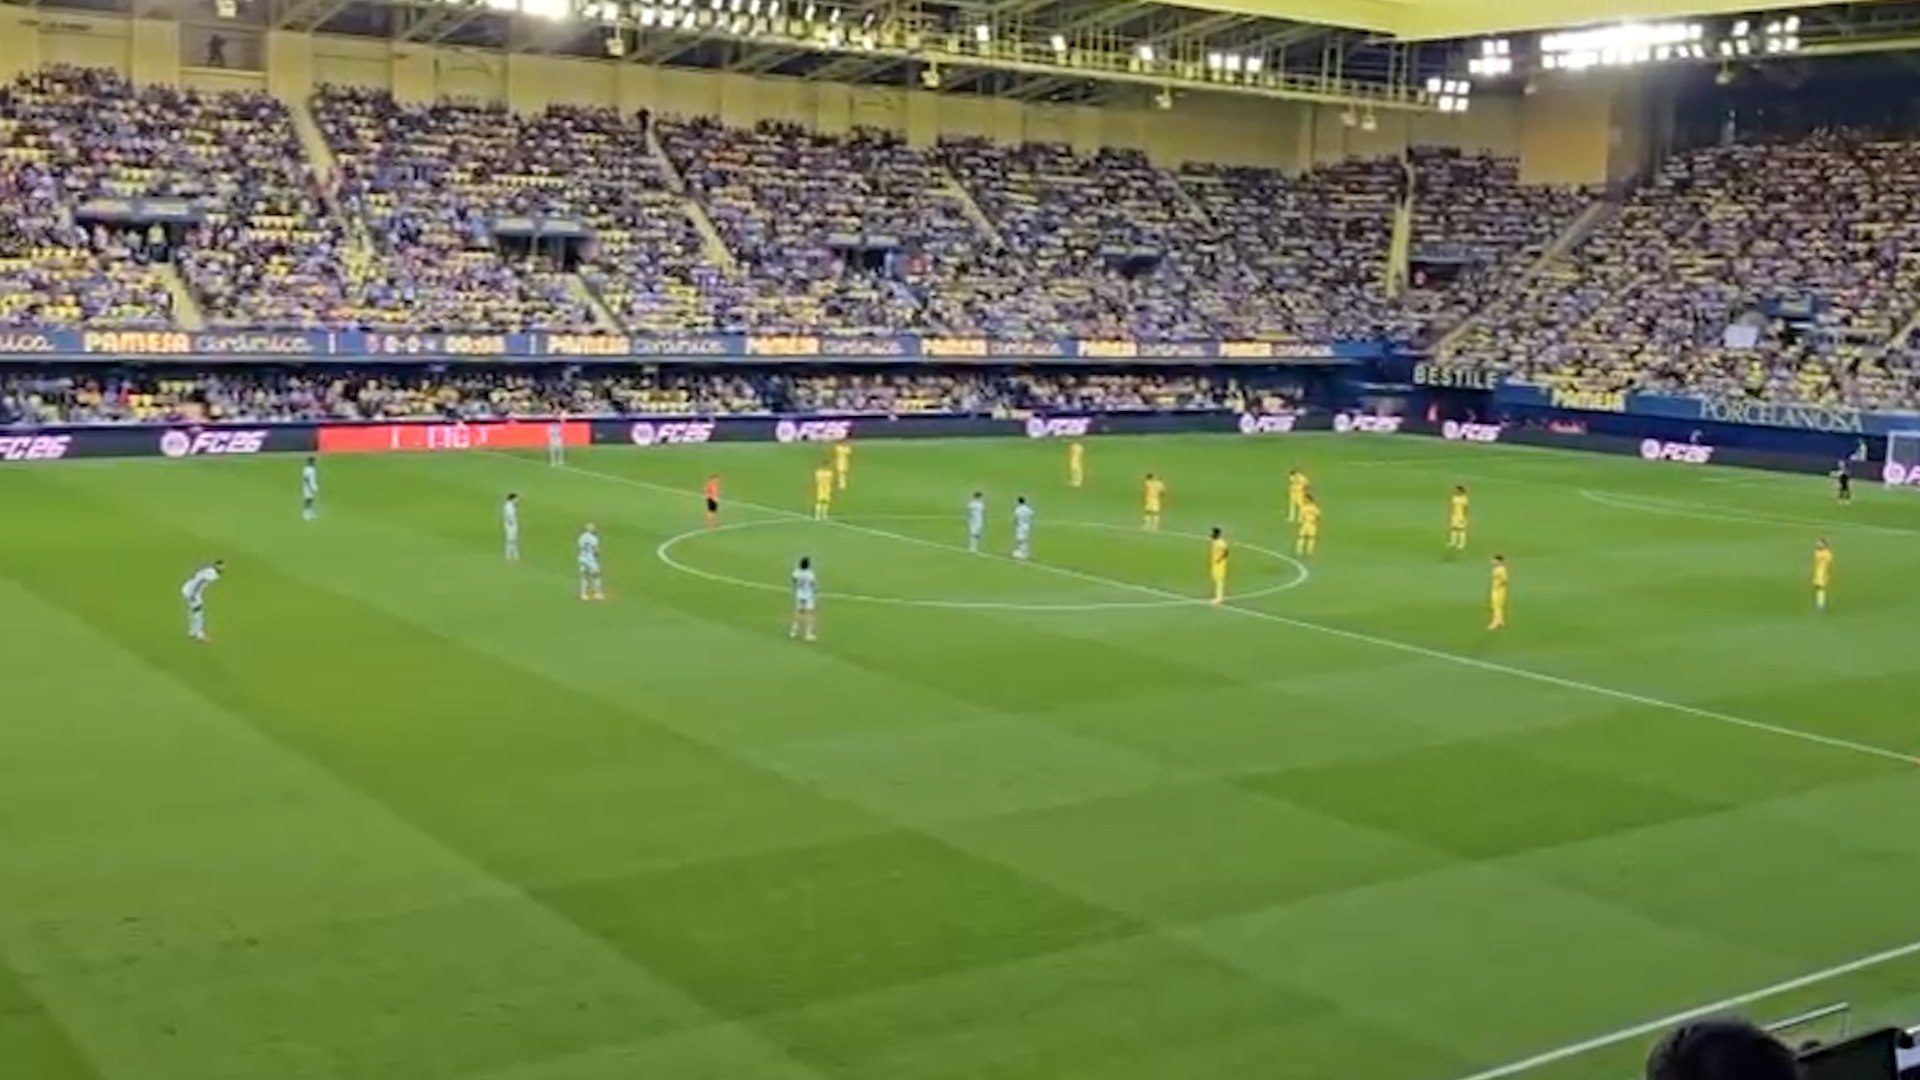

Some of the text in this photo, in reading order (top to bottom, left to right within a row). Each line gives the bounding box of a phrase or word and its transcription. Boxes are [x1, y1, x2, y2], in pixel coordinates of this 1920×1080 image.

[84, 332, 190, 352] PAMESA
[1413, 363, 1498, 389] BESTILE
[1699, 400, 1863, 434] PORCELANOSA
